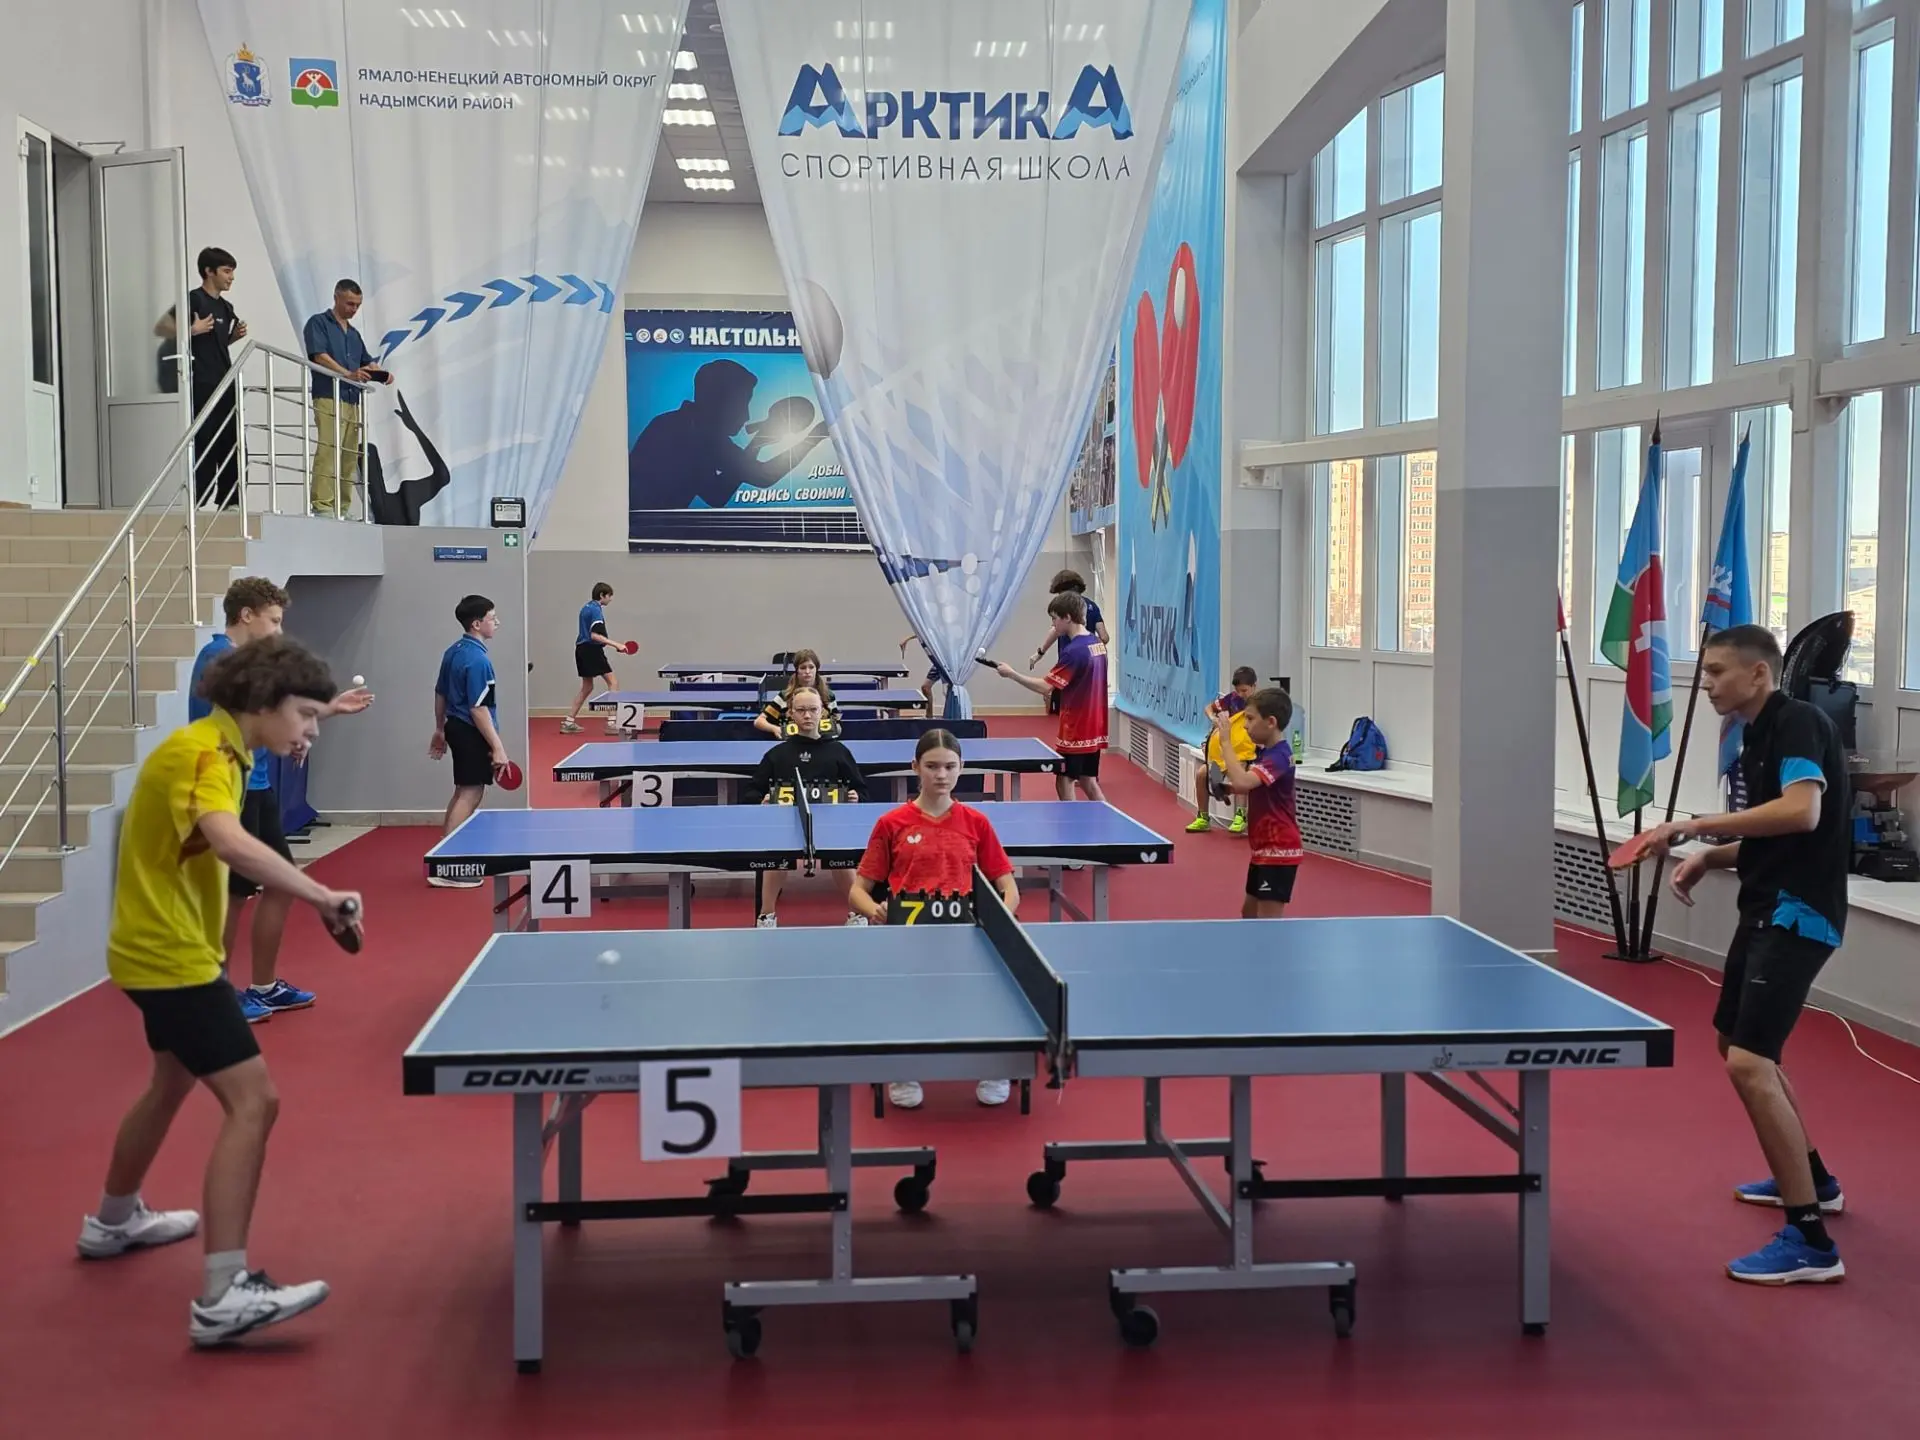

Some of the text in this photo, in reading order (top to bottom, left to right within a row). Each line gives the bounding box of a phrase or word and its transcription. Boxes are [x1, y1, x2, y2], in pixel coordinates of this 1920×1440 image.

[358, 68, 657, 87] ЯМАЛО-НЕНЕЦКИЙ АВТОНОМНЫЙ ОКРУГ
[359, 94, 514, 110] НАДЫМСКИЙ РАЙОН
[781, 153, 1131, 181] СПОРТИВНАЯ ШКОЛА
[735, 486, 846, 504] ГОРДИСЬ СВОИМИ
[622, 705, 637, 728] 2
[786, 719, 832, 736] 0 5
[561, 772, 594, 781] BUTTERFLY
[640, 774, 663, 807] 3
[778, 786, 839, 806] 5 0 1
[436, 864, 486, 877] BUTTERFLY
[542, 864, 579, 915] 4
[901, 901, 925, 927] 7
[1504, 1048, 1621, 1065] DONIC
[463, 1068, 590, 1087] DONIC
[661, 1067, 717, 1154] 5
